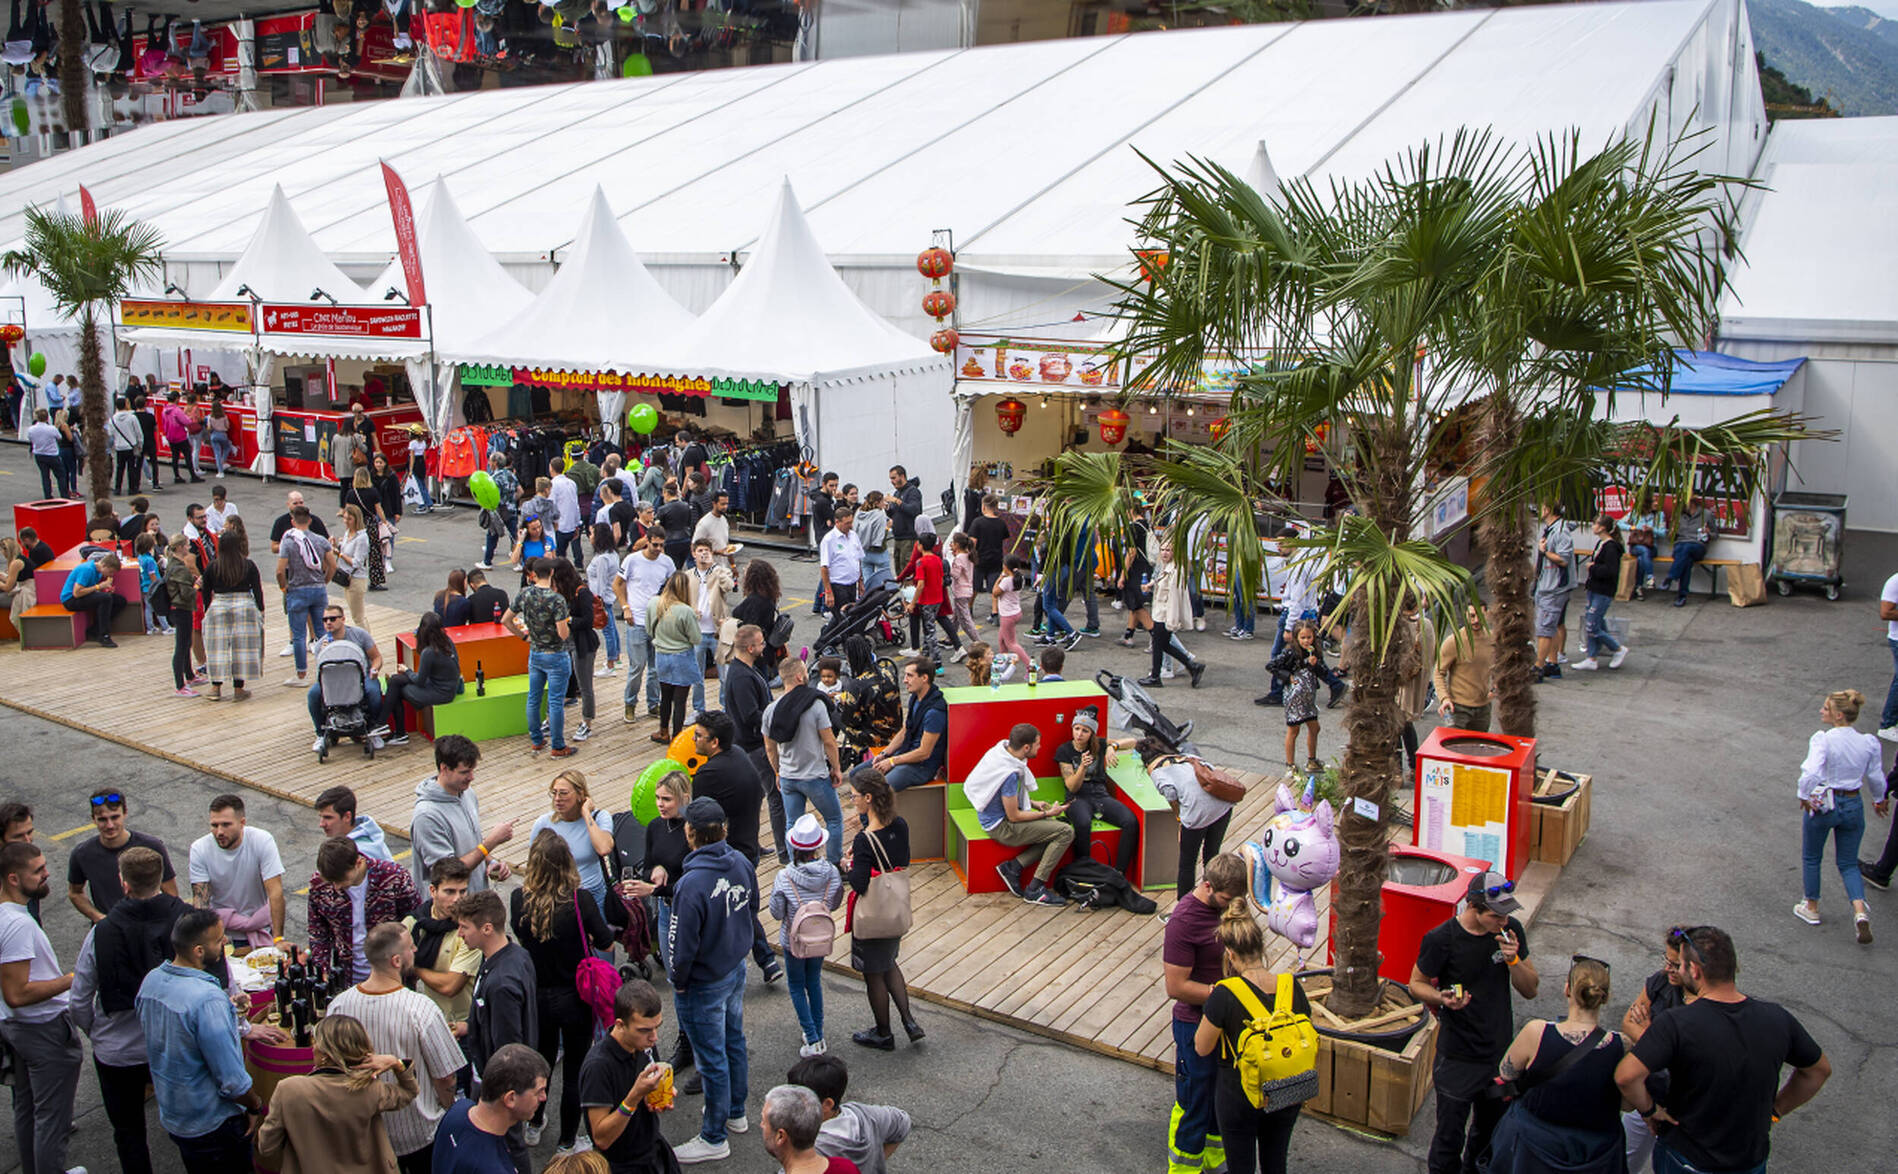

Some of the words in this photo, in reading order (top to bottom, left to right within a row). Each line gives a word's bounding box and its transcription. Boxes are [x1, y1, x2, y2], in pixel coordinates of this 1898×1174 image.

[531, 367, 595, 386] Comptoir
[598, 373, 622, 386] des
[626, 373, 711, 392] montagnes
